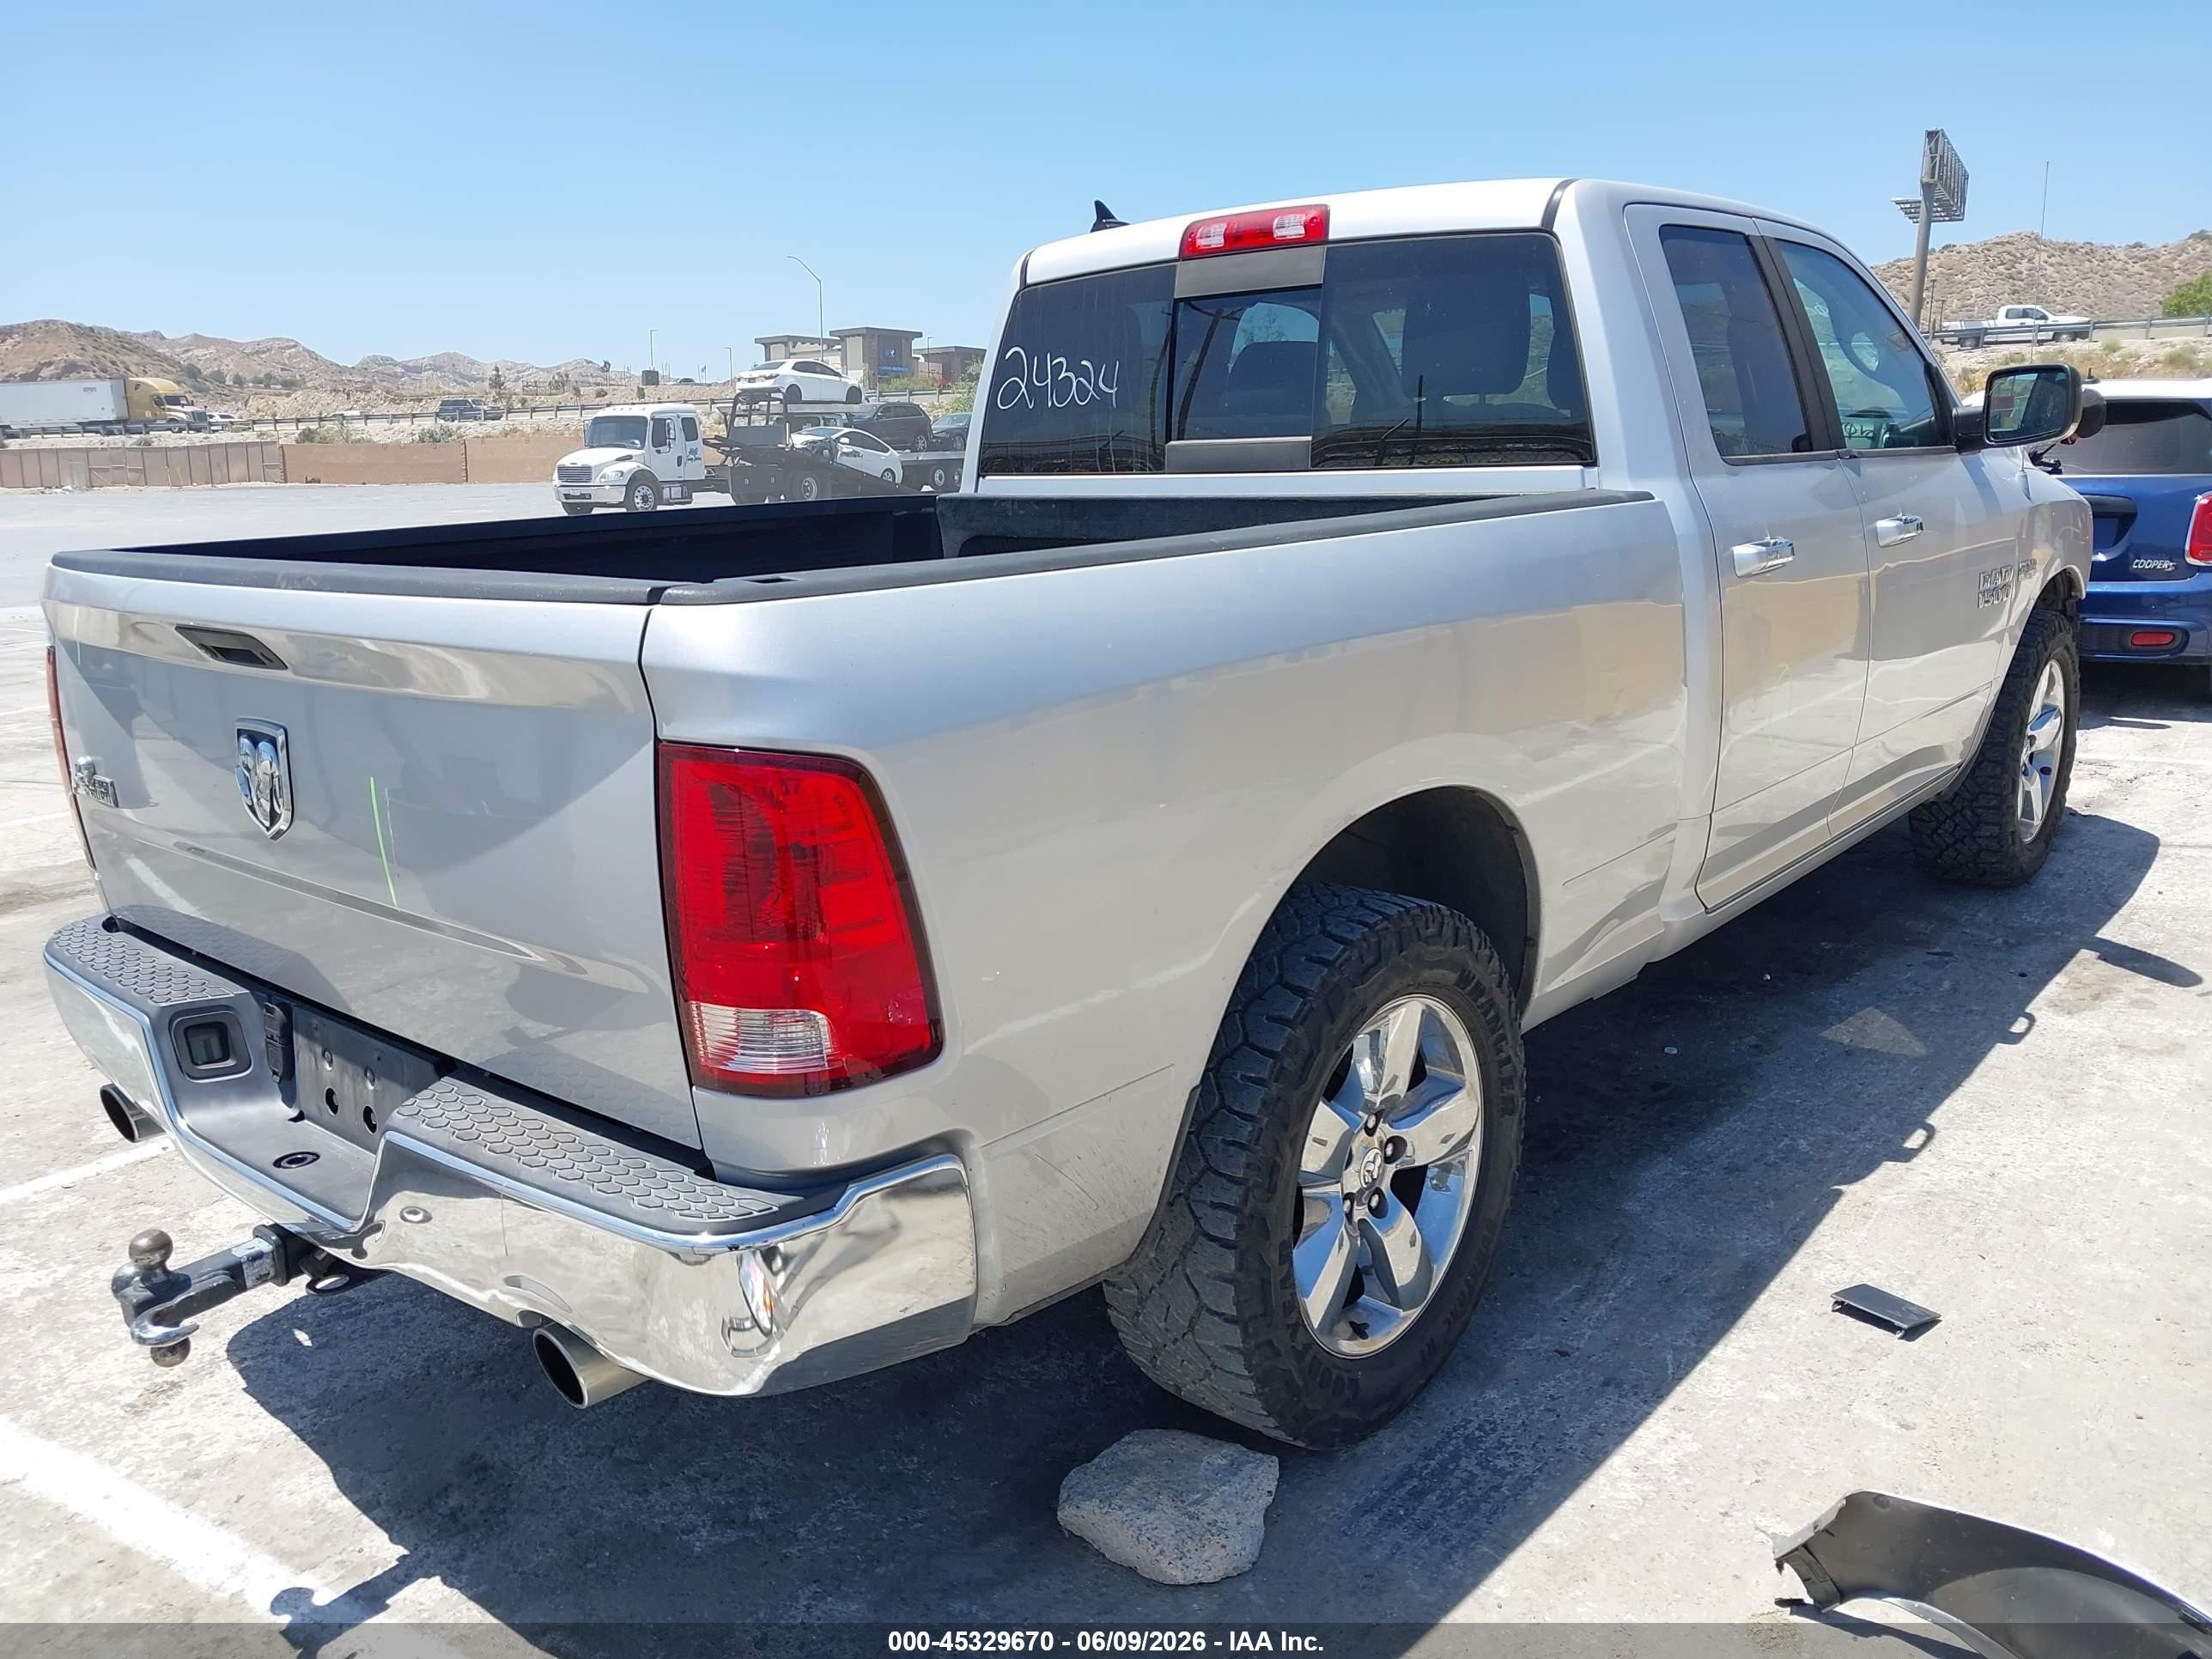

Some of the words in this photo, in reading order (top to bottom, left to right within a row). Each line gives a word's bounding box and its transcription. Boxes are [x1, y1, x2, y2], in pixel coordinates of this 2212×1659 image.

[997, 346, 1120, 410] 24324
[2132, 559, 2169, 569] COOPER
[1978, 565, 2014, 589] RAM
[1978, 586, 2012, 609] 1500
